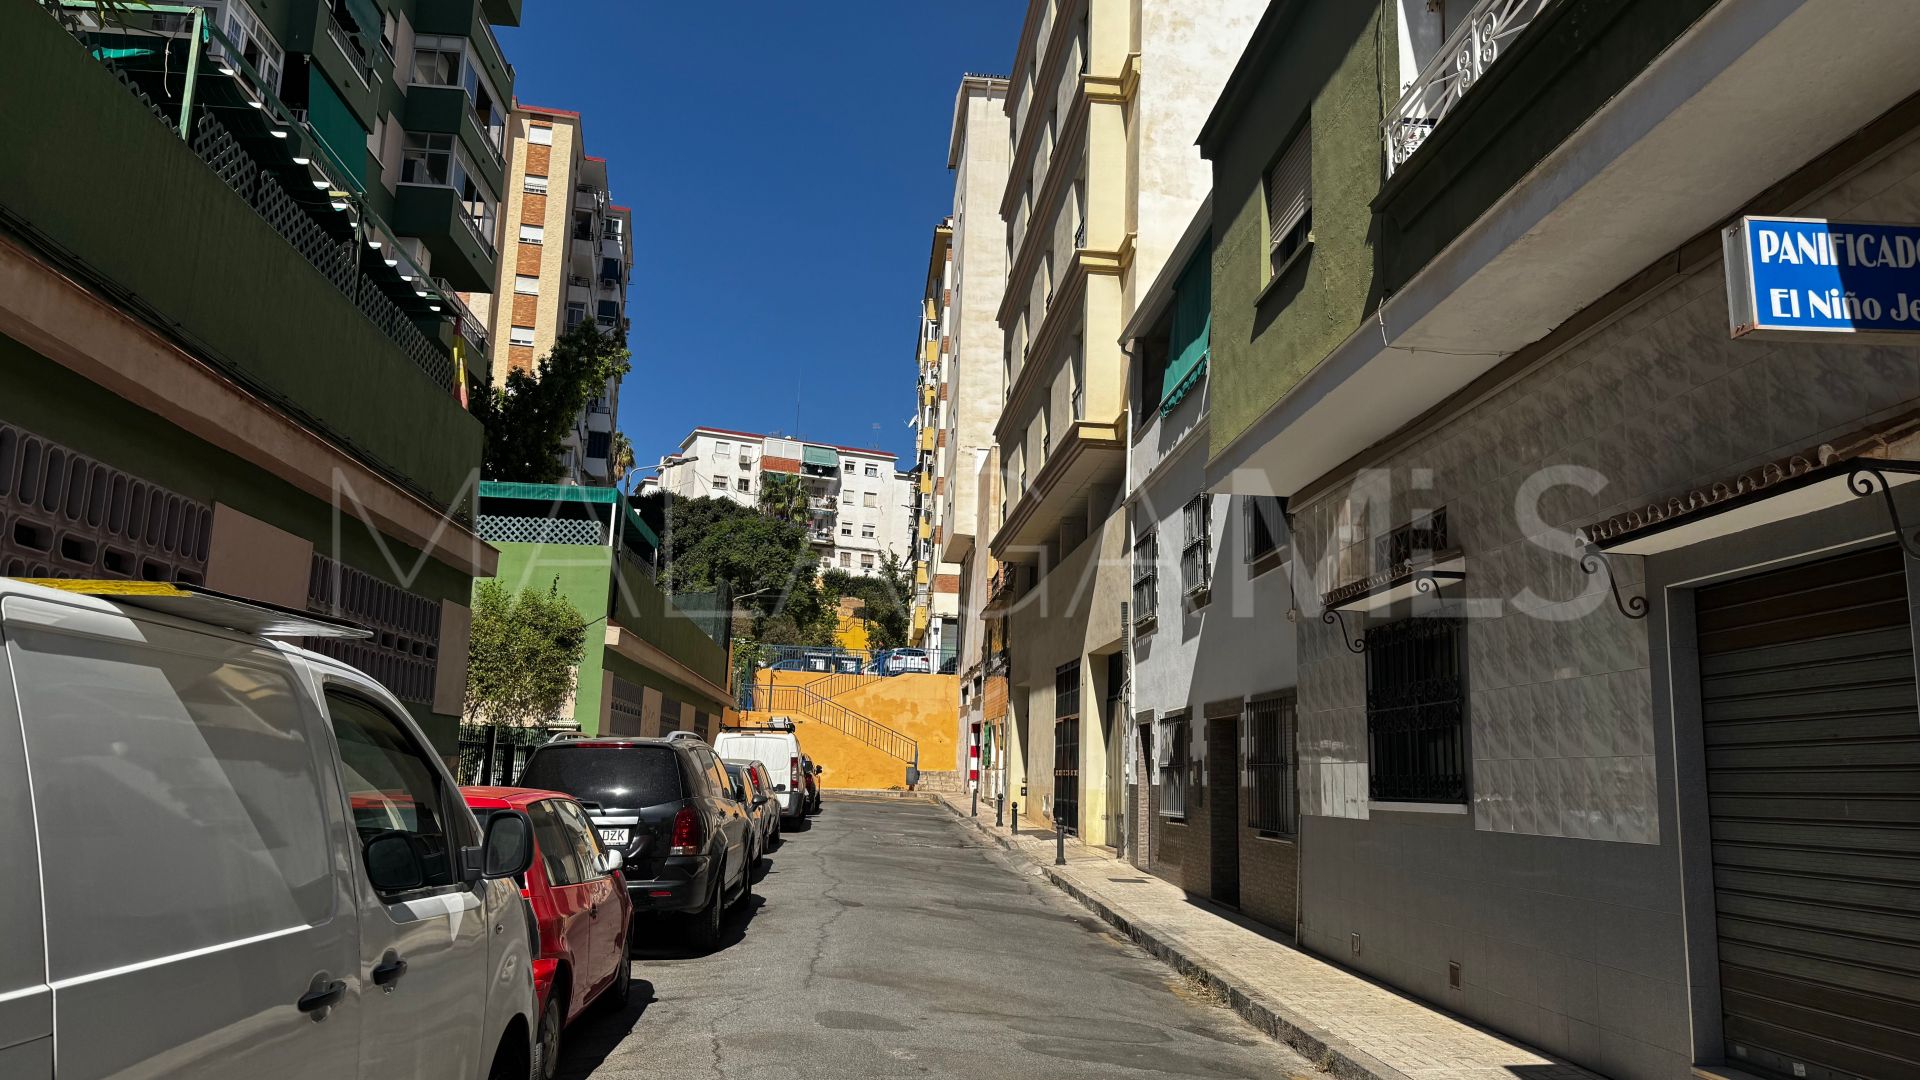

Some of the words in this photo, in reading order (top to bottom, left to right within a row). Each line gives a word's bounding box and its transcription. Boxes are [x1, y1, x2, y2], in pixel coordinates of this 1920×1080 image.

[1758, 229, 1920, 269] PANIFICAD
[1770, 288, 1800, 318] El
[1808, 288, 1882, 320] Niño
